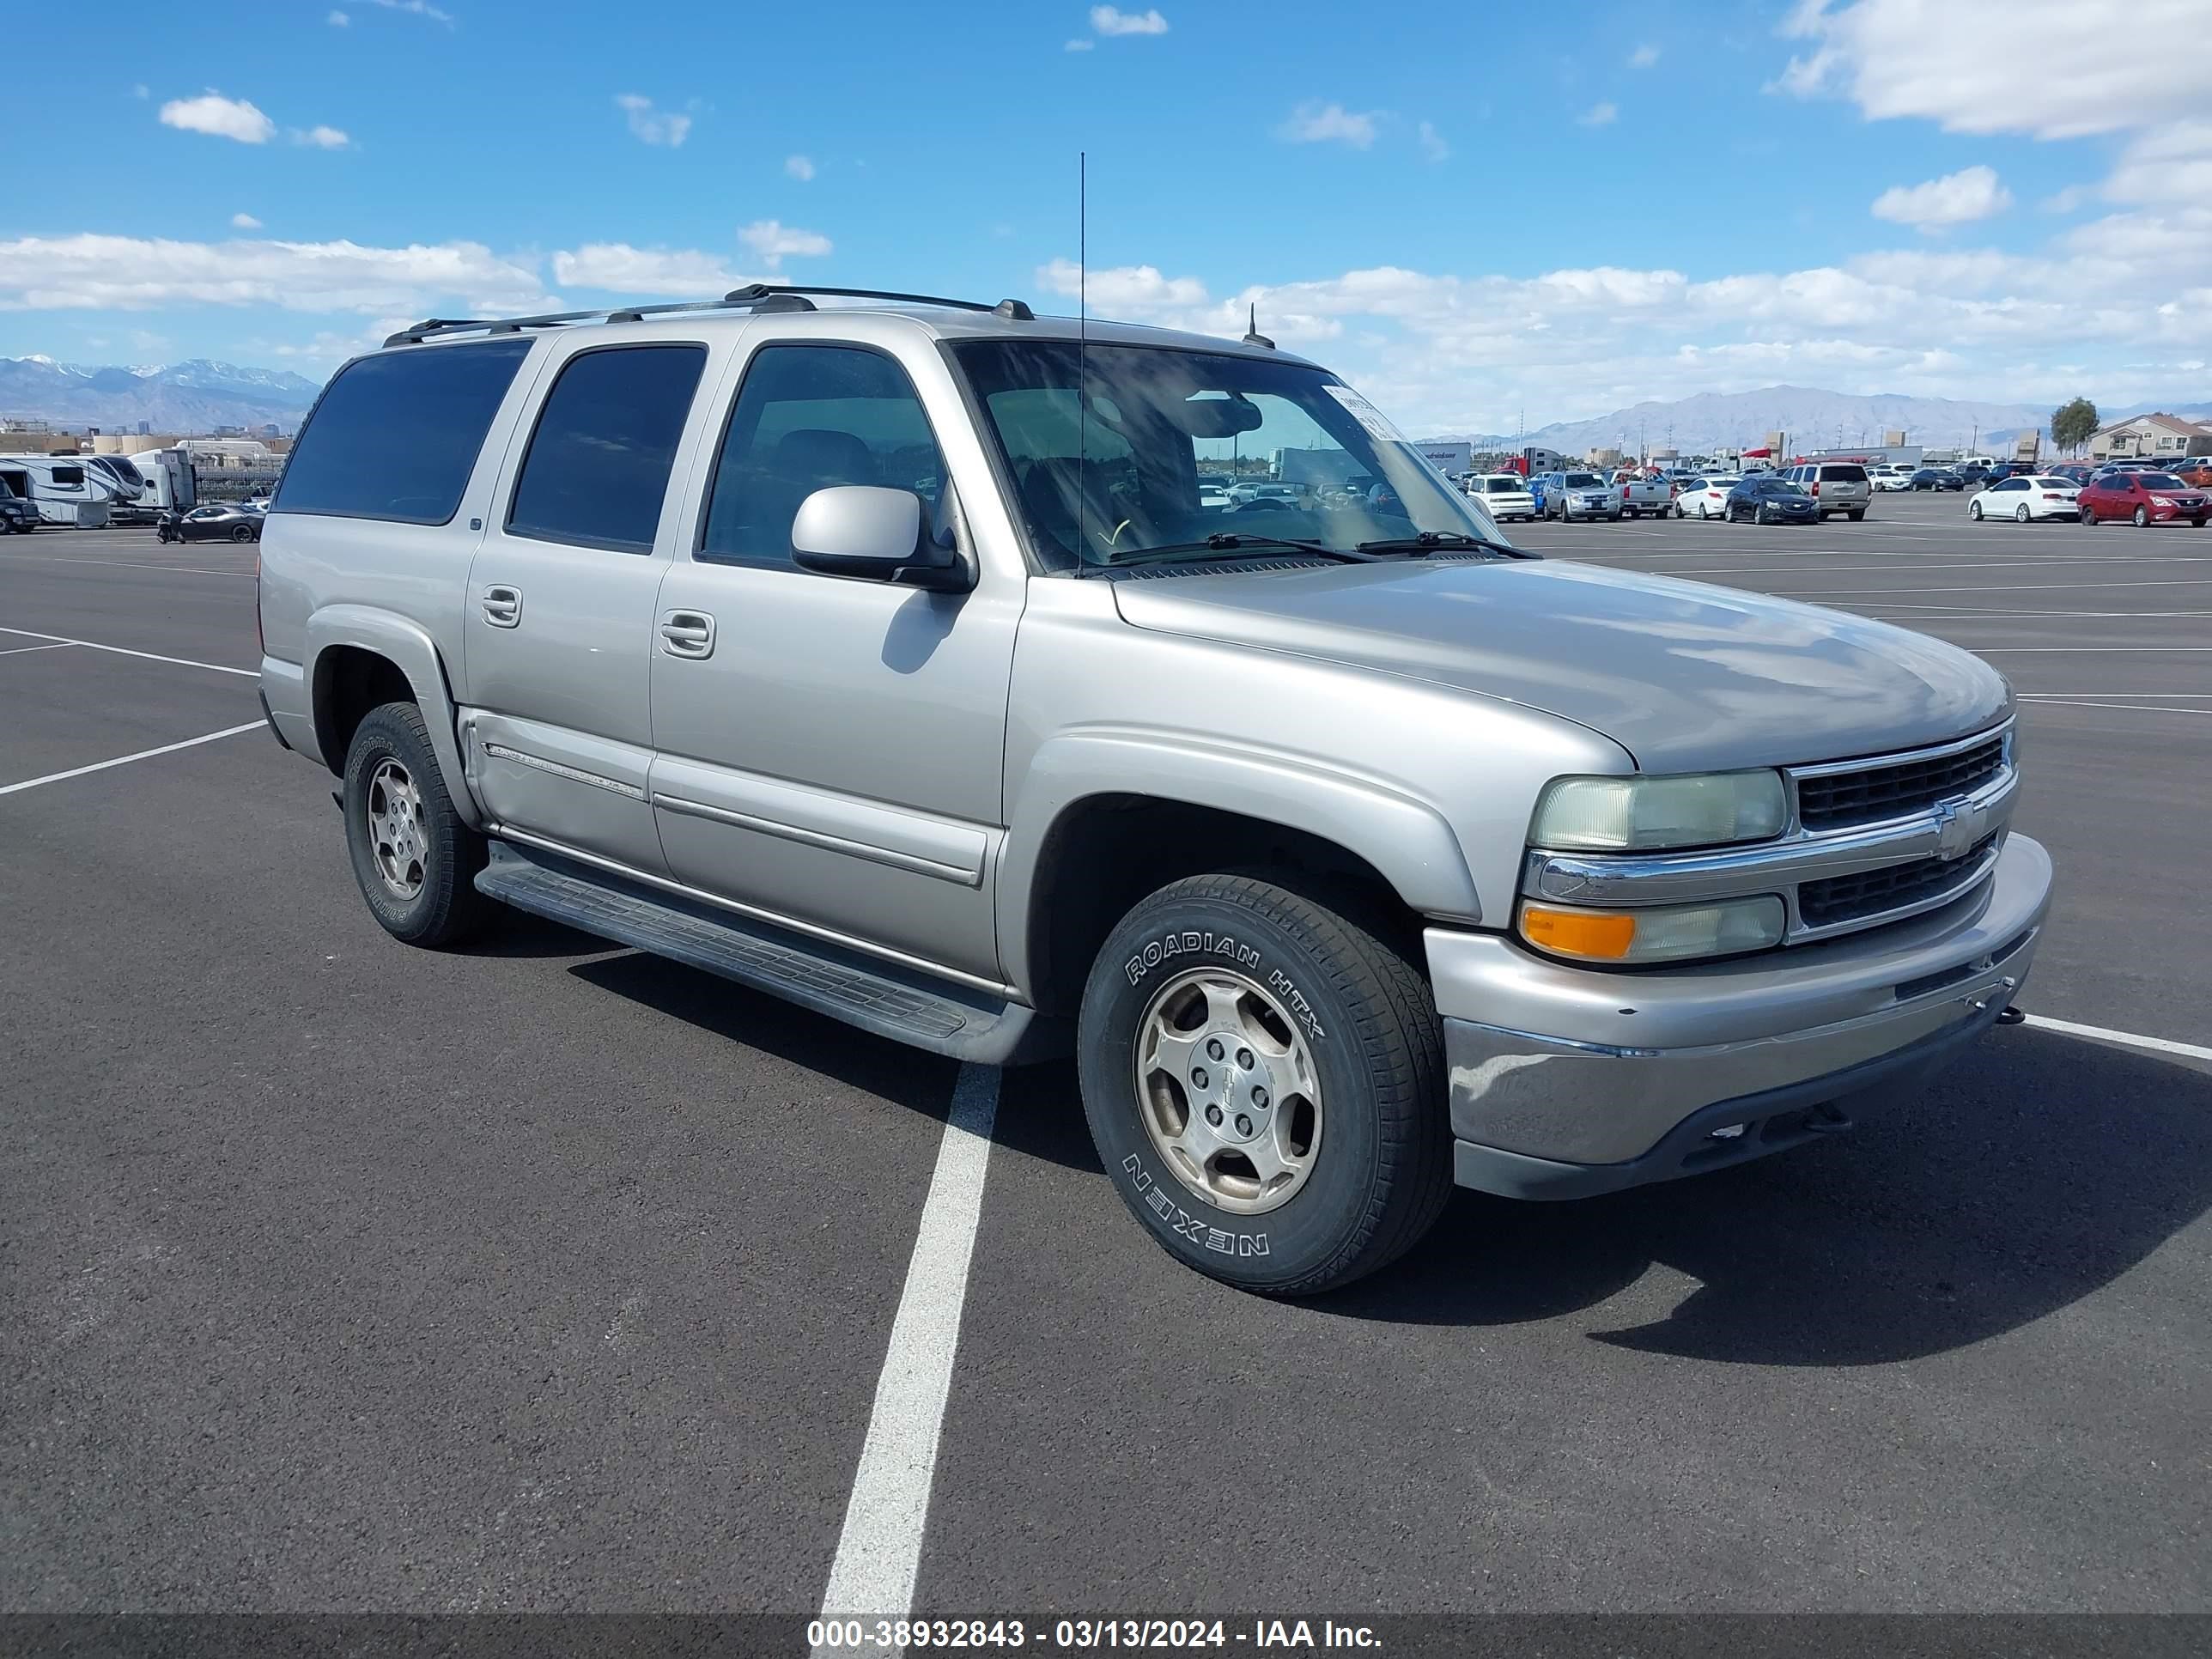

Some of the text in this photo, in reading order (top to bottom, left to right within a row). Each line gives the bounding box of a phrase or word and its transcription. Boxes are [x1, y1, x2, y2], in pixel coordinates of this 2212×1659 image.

[1123, 931, 1327, 1042] ROADIAN HTX
[1121, 1152, 1271, 1258] NEXEN
